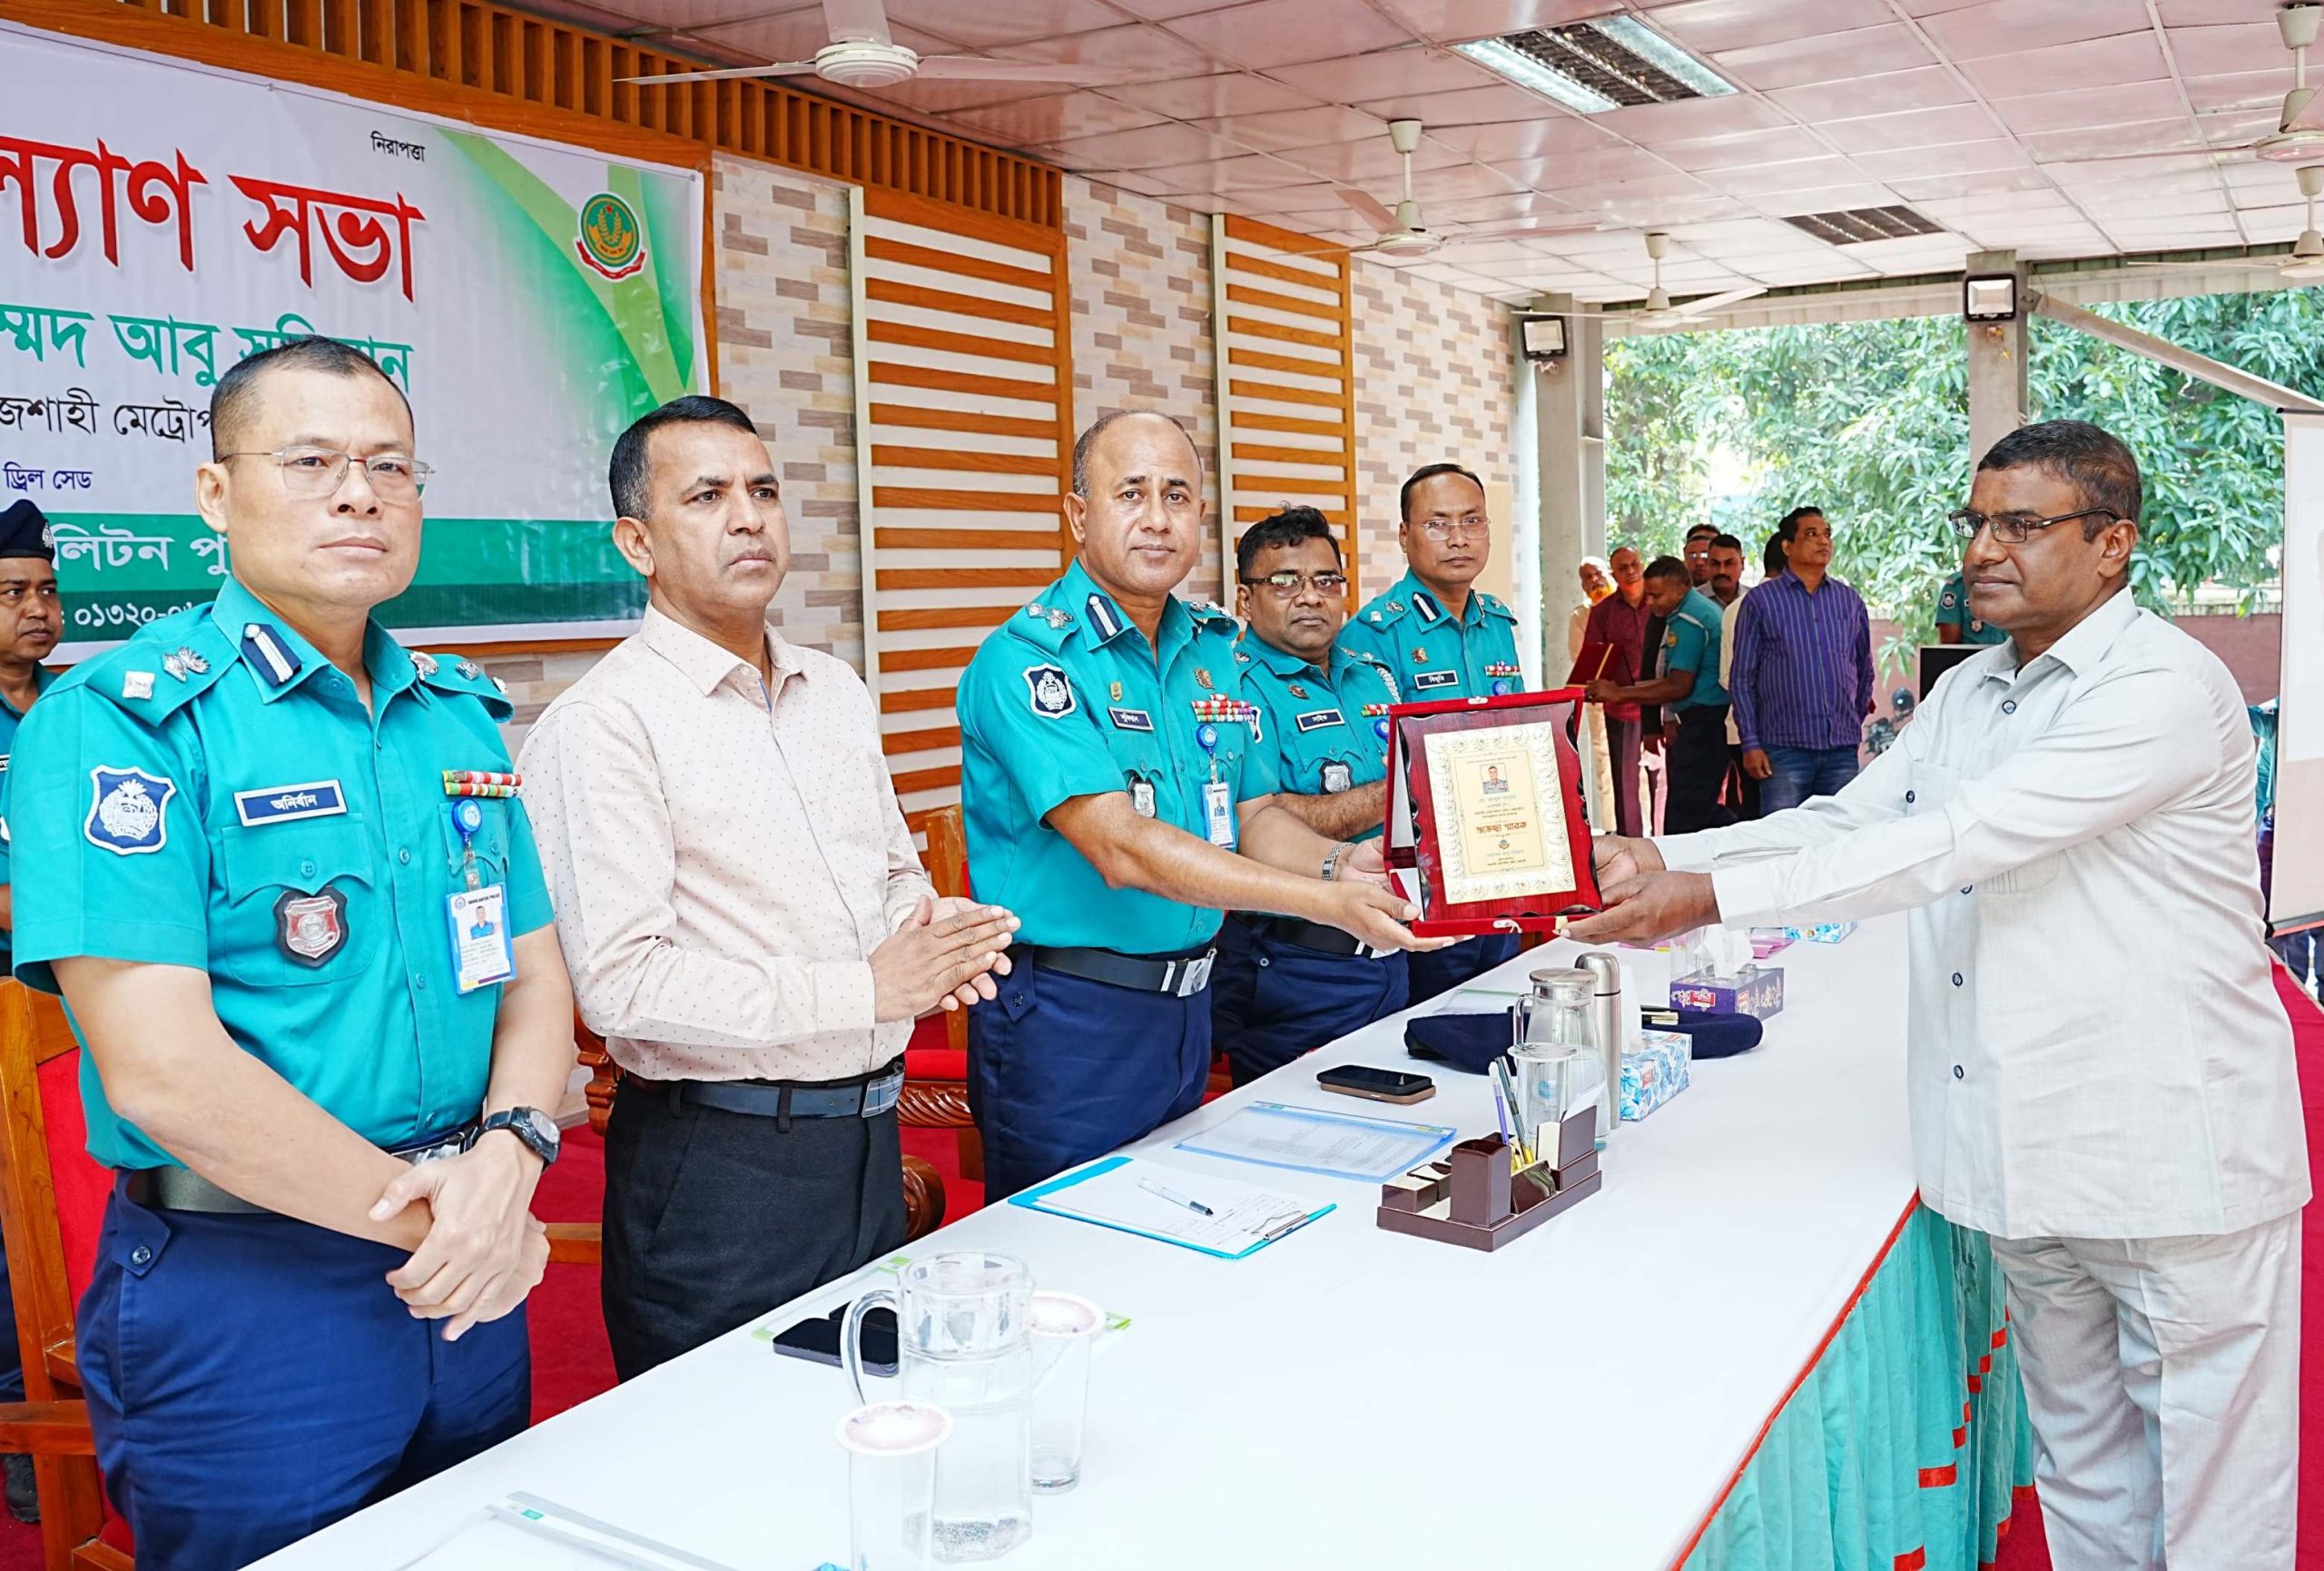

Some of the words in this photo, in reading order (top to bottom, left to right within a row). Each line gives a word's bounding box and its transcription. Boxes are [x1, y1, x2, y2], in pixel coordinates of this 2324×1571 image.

[370, 131, 426, 163] নিরাপত্তা
[227, 174, 426, 303] সভা
[106, 314, 221, 387] আবু
[2, 460, 45, 492] ড্রিল
[53, 470, 93, 490] সেড
[52, 523, 175, 571] লিটন
